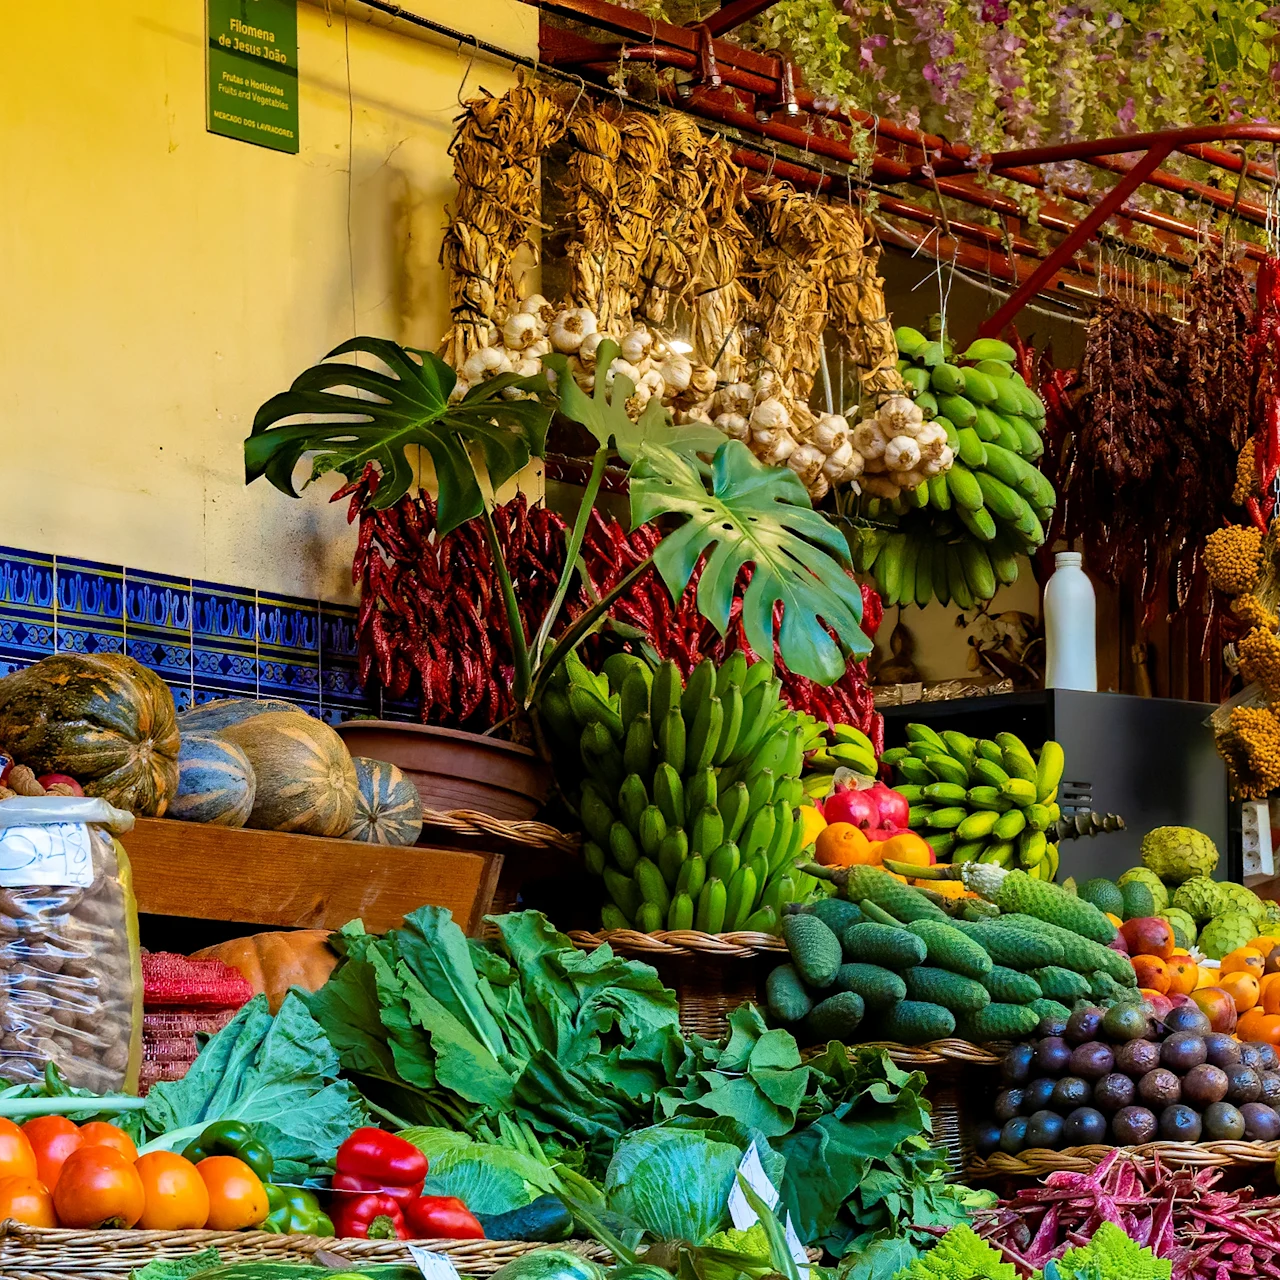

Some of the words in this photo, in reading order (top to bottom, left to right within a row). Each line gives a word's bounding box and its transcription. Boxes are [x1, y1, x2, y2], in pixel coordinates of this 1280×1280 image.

[229, 18, 275, 43] Filomena
[218, 33, 232, 48] de
[233, 37, 261, 57] Jesus
[263, 46, 287, 65] João
[222, 71, 244, 85] Frutas
[218, 83, 238, 96] Fruits
[238, 90, 251, 100] and
[252, 92, 289, 110] Vegetables
[213, 110, 243, 125] MERCADO
[243, 118, 256, 128] DOS
[256, 122, 294, 139] LAVRADORES
